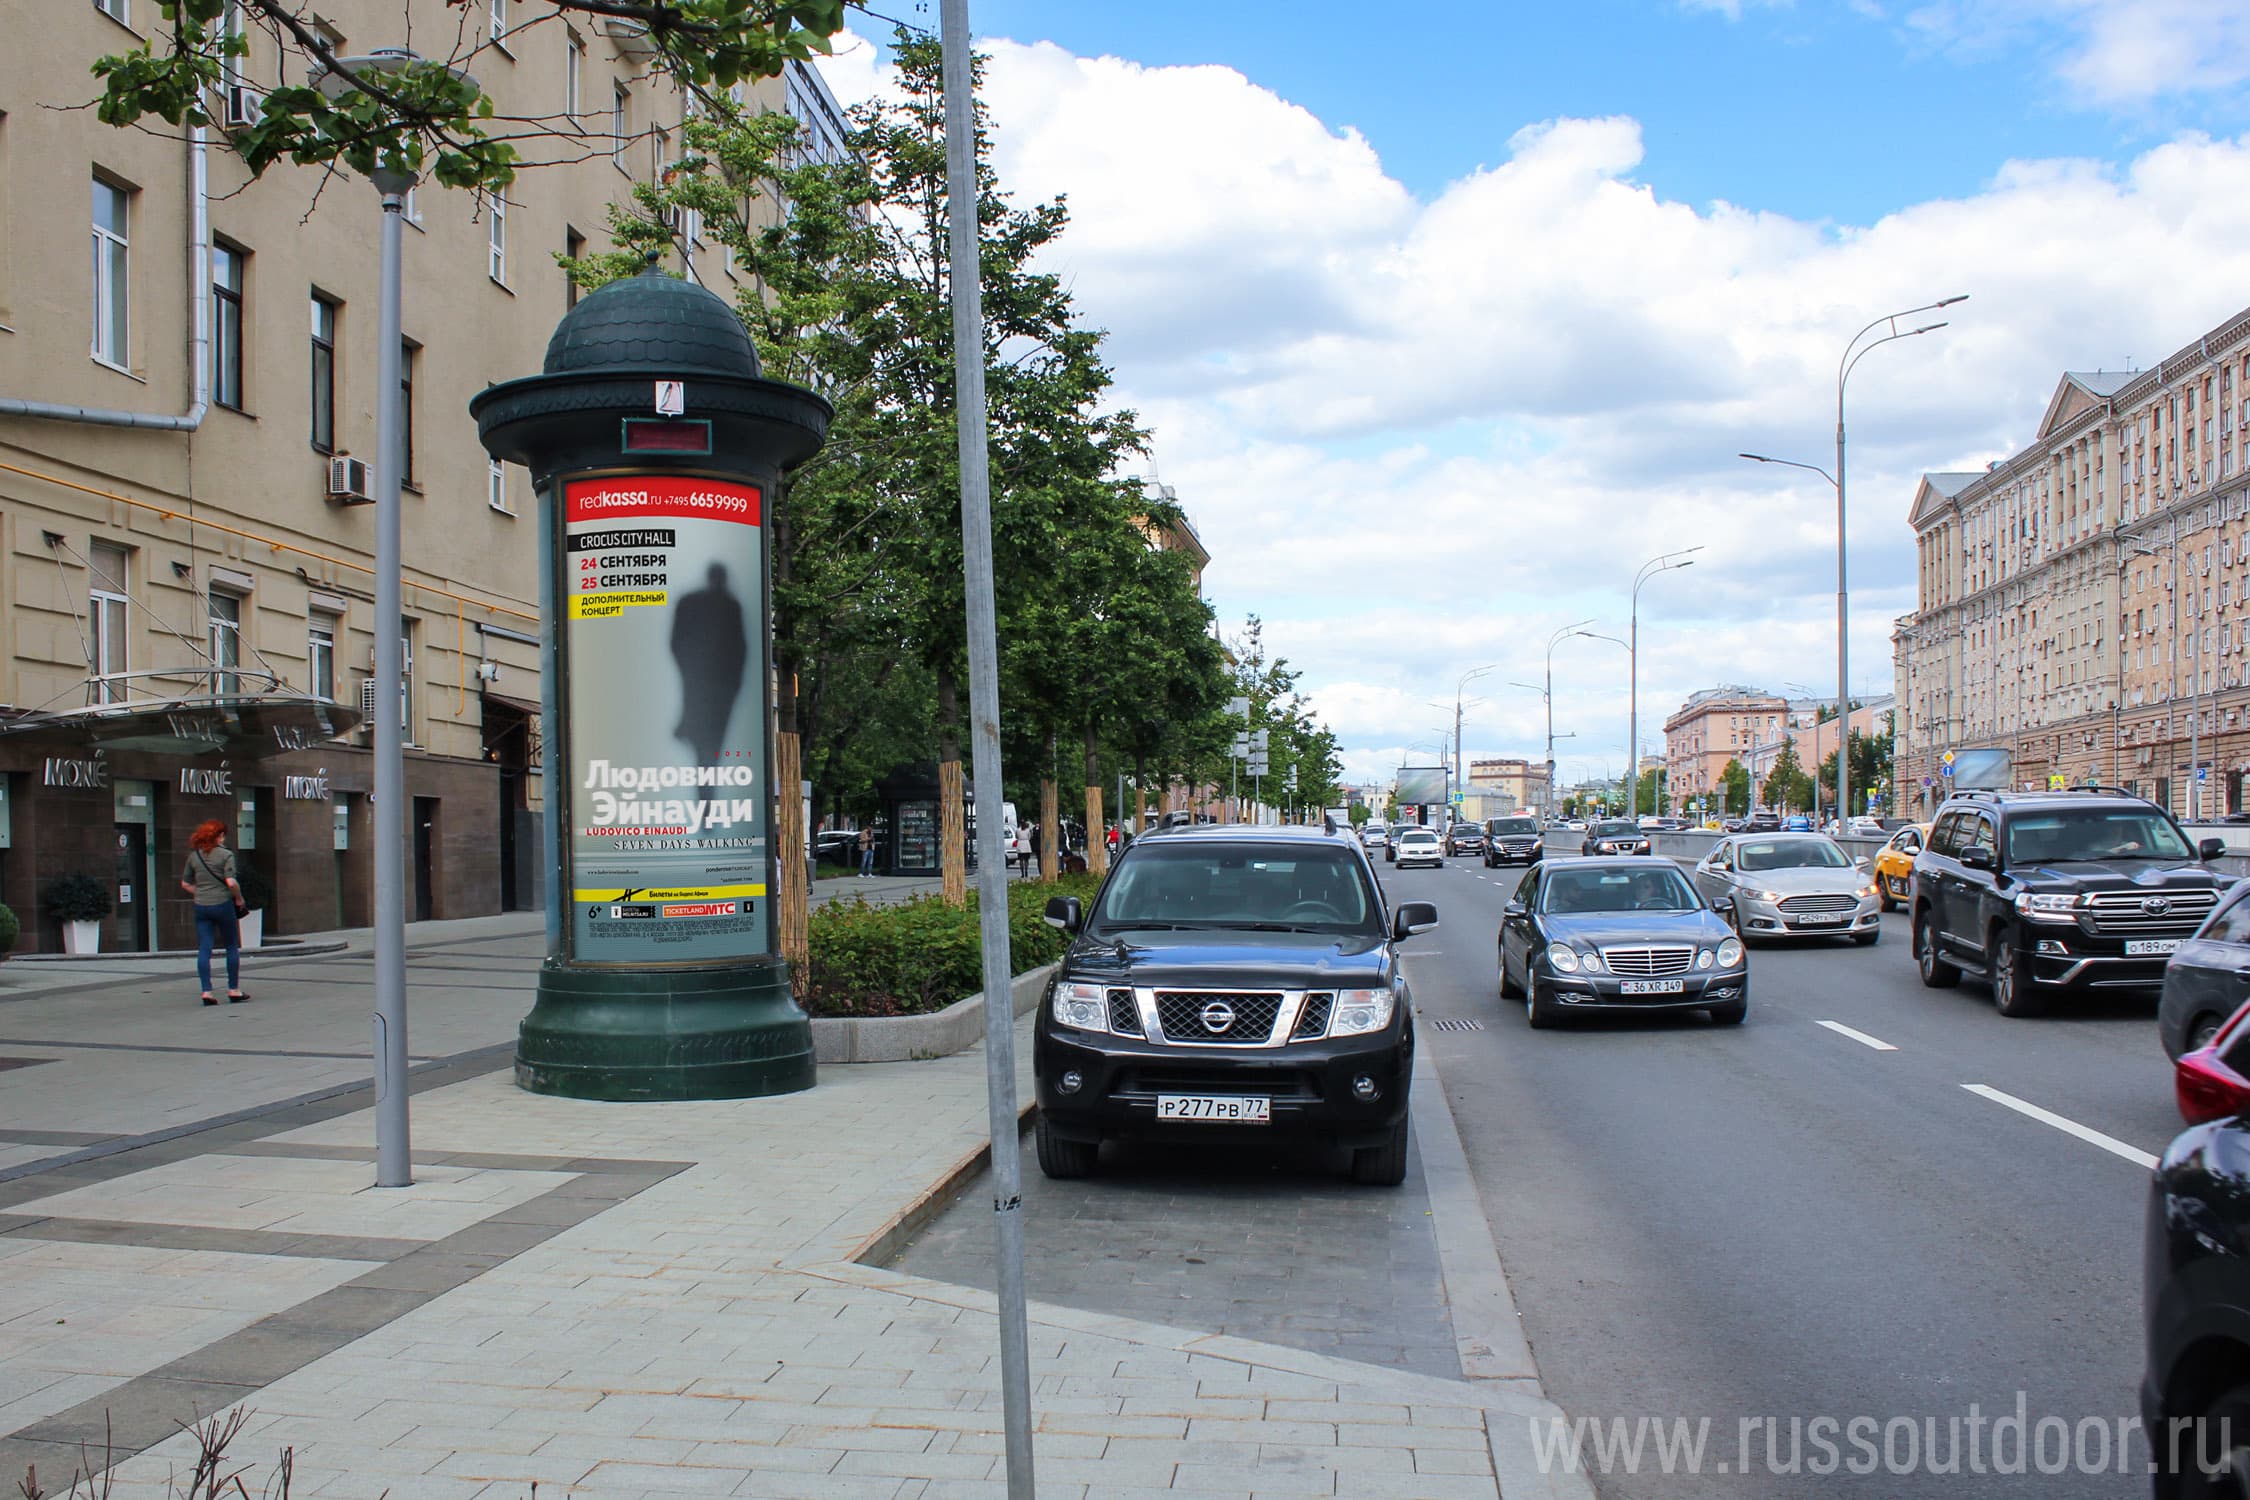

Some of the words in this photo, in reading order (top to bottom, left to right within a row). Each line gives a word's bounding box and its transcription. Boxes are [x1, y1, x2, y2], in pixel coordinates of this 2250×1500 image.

[579, 490, 662, 510] redkassa.ru
[690, 491, 748, 513] 6659999
[580, 533, 620, 549] CROCUS
[621, 532, 643, 546] CITY
[645, 532, 673, 545] HALL
[581, 557, 597, 570] 24
[600, 555, 667, 569] СЕНТЯБРЯ
[581, 577, 597, 590] 25
[600, 574, 667, 588] СЕНТЯБРЯ
[581, 592, 665, 606] ДОПОЛНИТЕЛЬНЫЙ
[581, 606, 620, 617] КОНЦЕРТ
[584, 760, 753, 792] Людовико
[592, 791, 752, 834] Эйнауди
[586, 827, 641, 836] LUDOVICO
[644, 826, 687, 835] EINAUDI
[614, 839, 655, 850] SEVEN
[660, 838, 691, 849] DAYS
[588, 905, 602, 919] 6+
[1633, 982, 1646, 992] 36
[1664, 981, 1680, 992] 149
